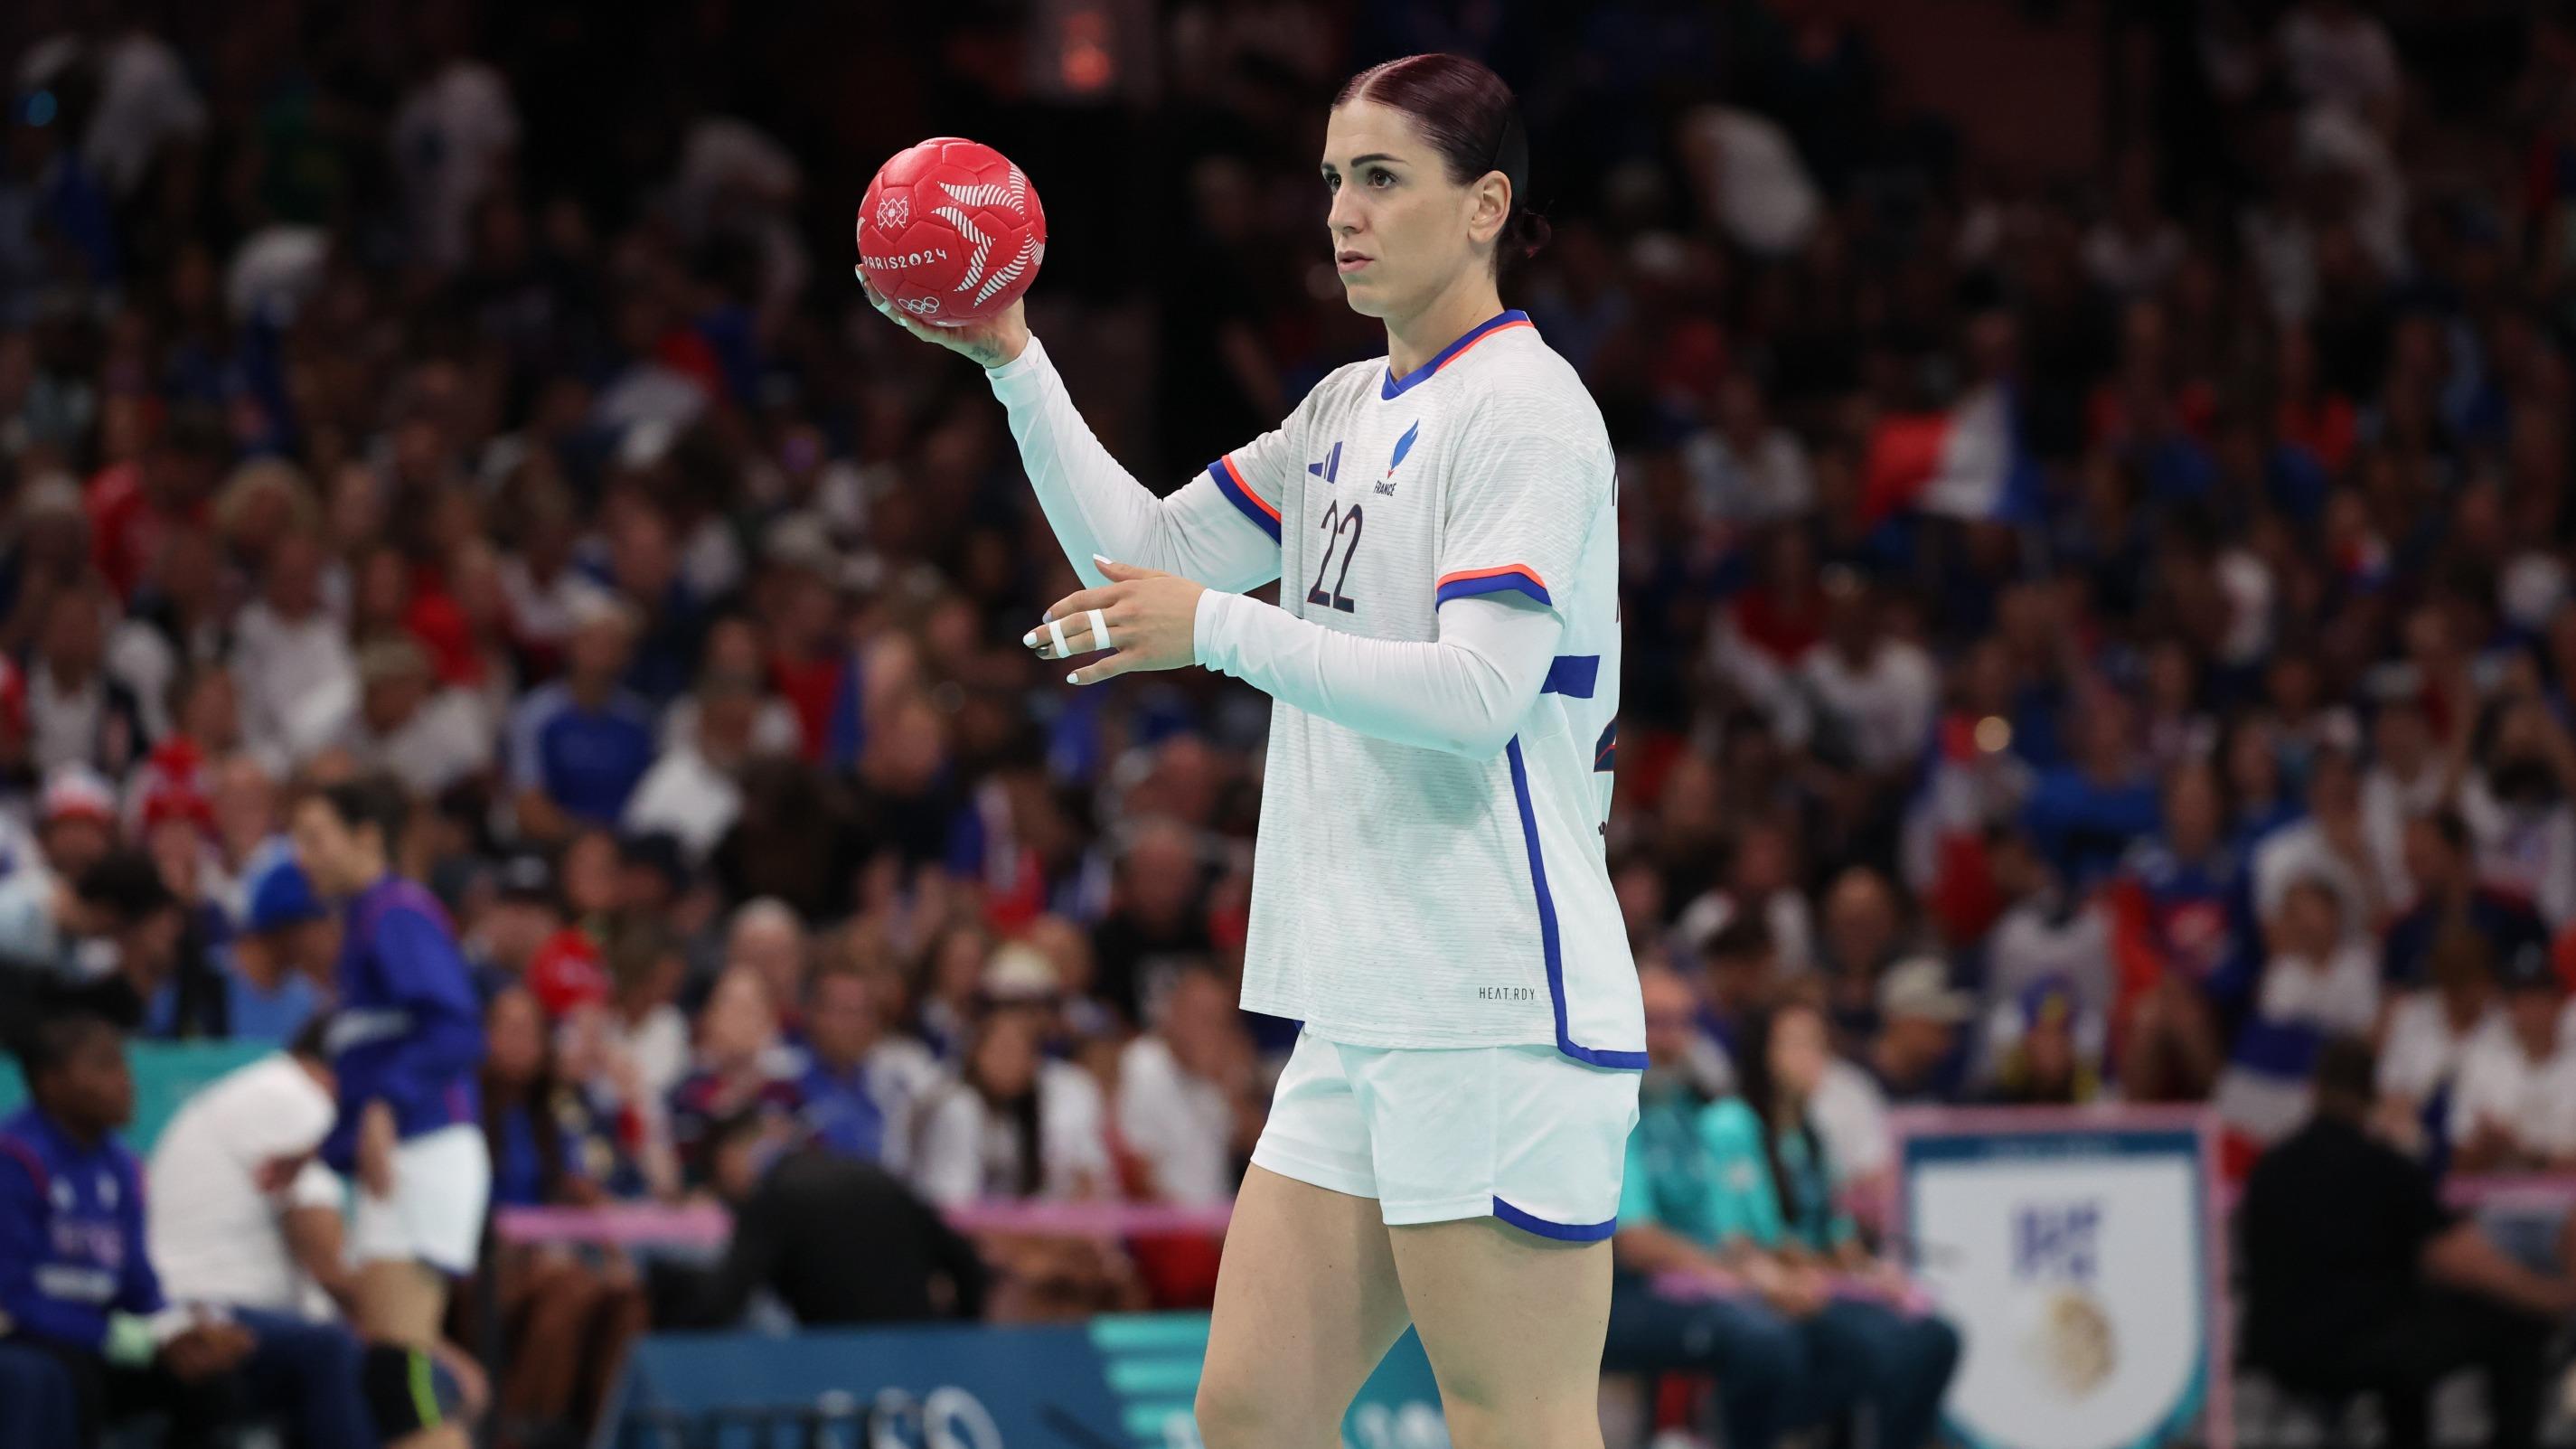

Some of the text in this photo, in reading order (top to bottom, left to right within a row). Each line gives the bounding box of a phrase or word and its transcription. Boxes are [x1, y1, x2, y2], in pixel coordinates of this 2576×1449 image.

[1373, 480, 1397, 497] FRANCE
[1307, 499, 1363, 614] 22
[1479, 986, 1536, 1001] HEAT.RDY
